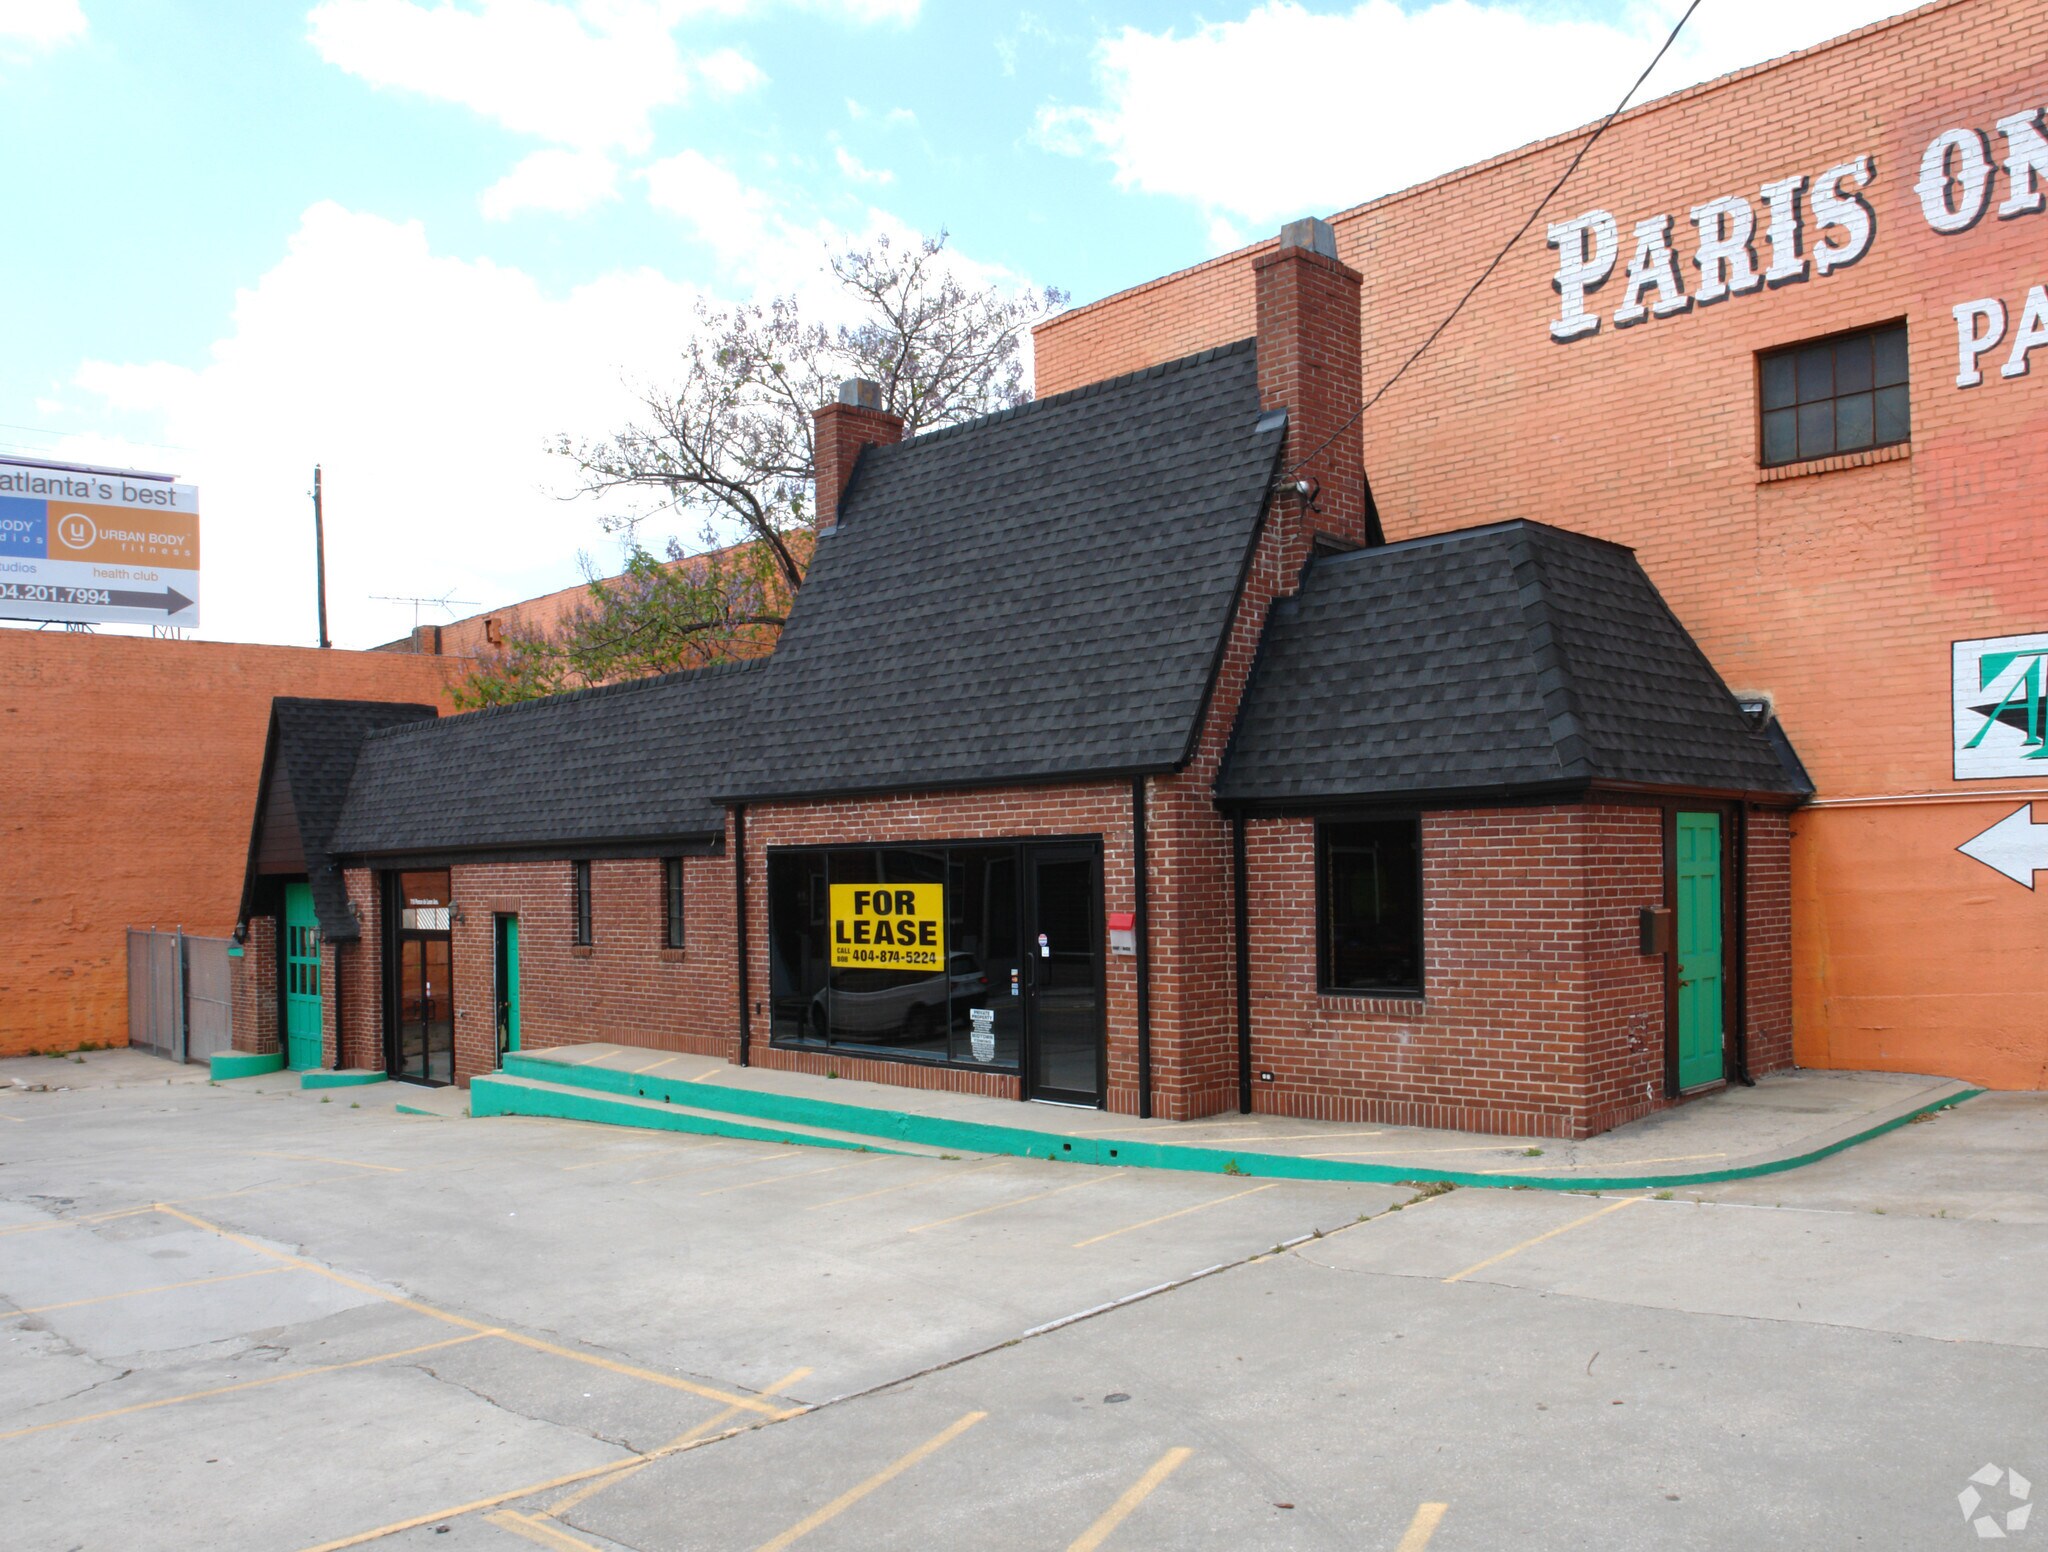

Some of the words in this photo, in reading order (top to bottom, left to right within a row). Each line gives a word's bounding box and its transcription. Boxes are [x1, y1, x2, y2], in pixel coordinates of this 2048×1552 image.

[1547, 155, 1876, 342] PARIS
[0, 472, 112, 500] atlanta's
[122, 481, 177, 506] best
[0, 519, 33, 532] ODY
[99, 529, 145, 542] URBAN
[149, 533, 185, 545] BODY
[121, 543, 192, 556] fitness
[93, 567, 130, 579] health
[133, 570, 159, 582] club
[854, 890, 915, 915] FOR
[836, 920, 937, 946] LEASE
[852, 949, 937, 964] 404-874-5224
